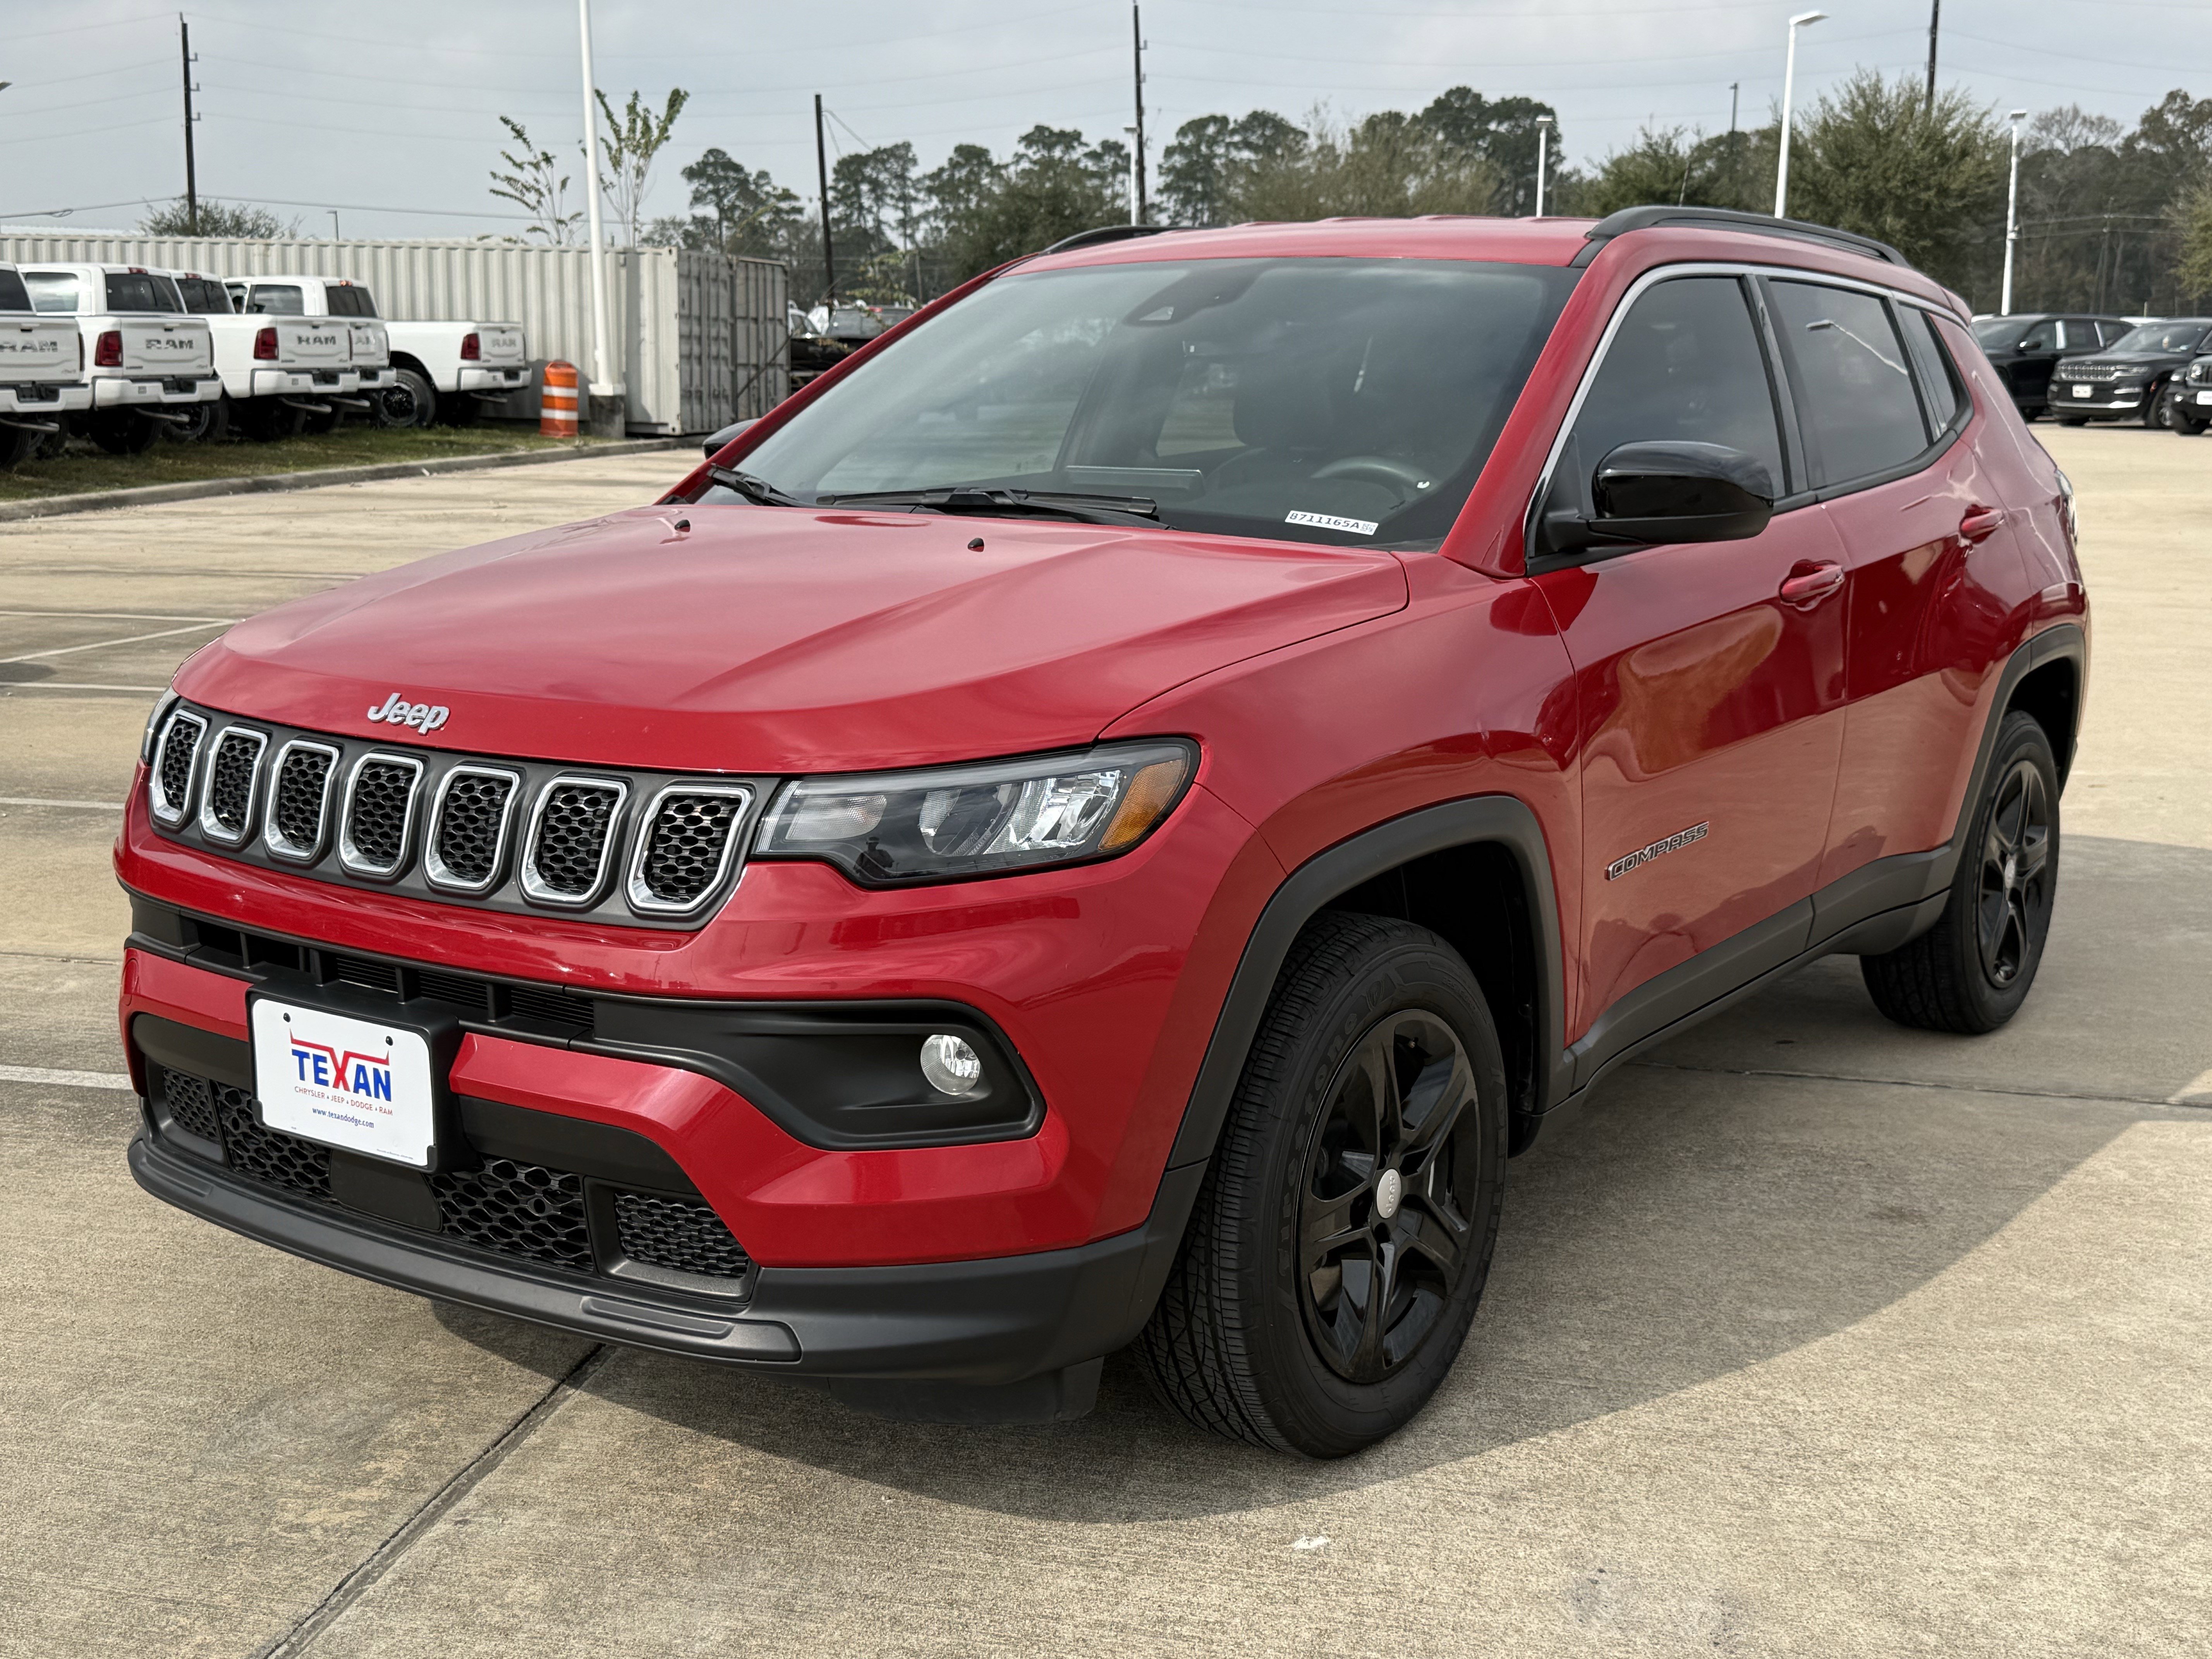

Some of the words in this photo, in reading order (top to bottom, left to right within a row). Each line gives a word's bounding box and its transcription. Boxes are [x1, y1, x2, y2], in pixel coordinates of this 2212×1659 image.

[145, 339, 194, 350] RAM
[297, 335, 336, 345] RAM
[1289, 512, 1359, 529] 8711165A
[368, 692, 450, 736] Jeep
[1608, 821, 1709, 881] COMPASS
[291, 1046, 392, 1102] TEXAN
[294, 1086, 325, 1099] CHRYSLER
[331, 1094, 345, 1104] JEEP
[350, 1099, 373, 1111] DODGE
[379, 1106, 393, 1116] RAM
[312, 1108, 374, 1129] www.texandodge.com
[1384, 1176, 1395, 1213] Jeep
